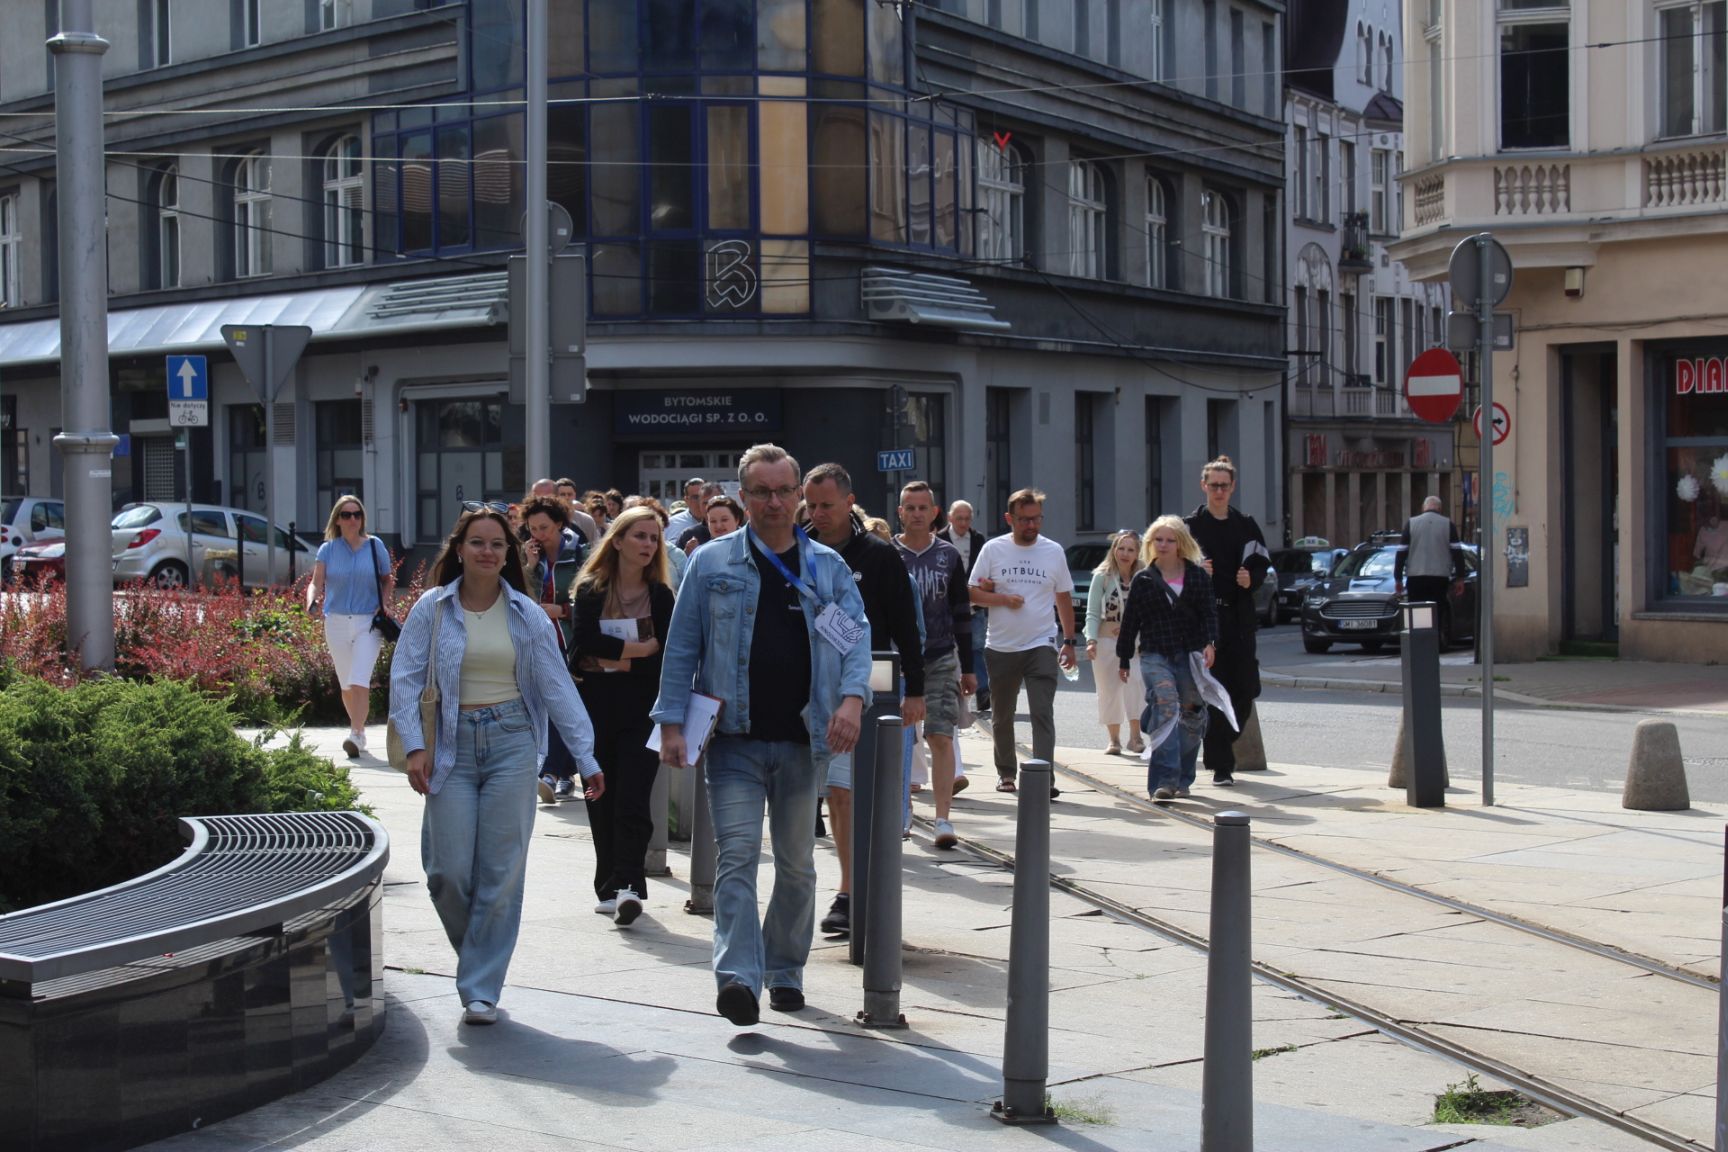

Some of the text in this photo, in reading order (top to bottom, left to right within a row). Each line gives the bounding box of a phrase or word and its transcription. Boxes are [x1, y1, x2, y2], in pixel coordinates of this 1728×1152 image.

[1676, 357, 1728, 394] DIA
[183, 402, 206, 410] dotyczy
[664, 396, 732, 407] BYTOMSKIE
[628, 412, 768, 426] WODOCIĄGI SP. Z O. O.
[880, 452, 912, 469] TAXI
[1001, 567, 1047, 578] PITBULL
